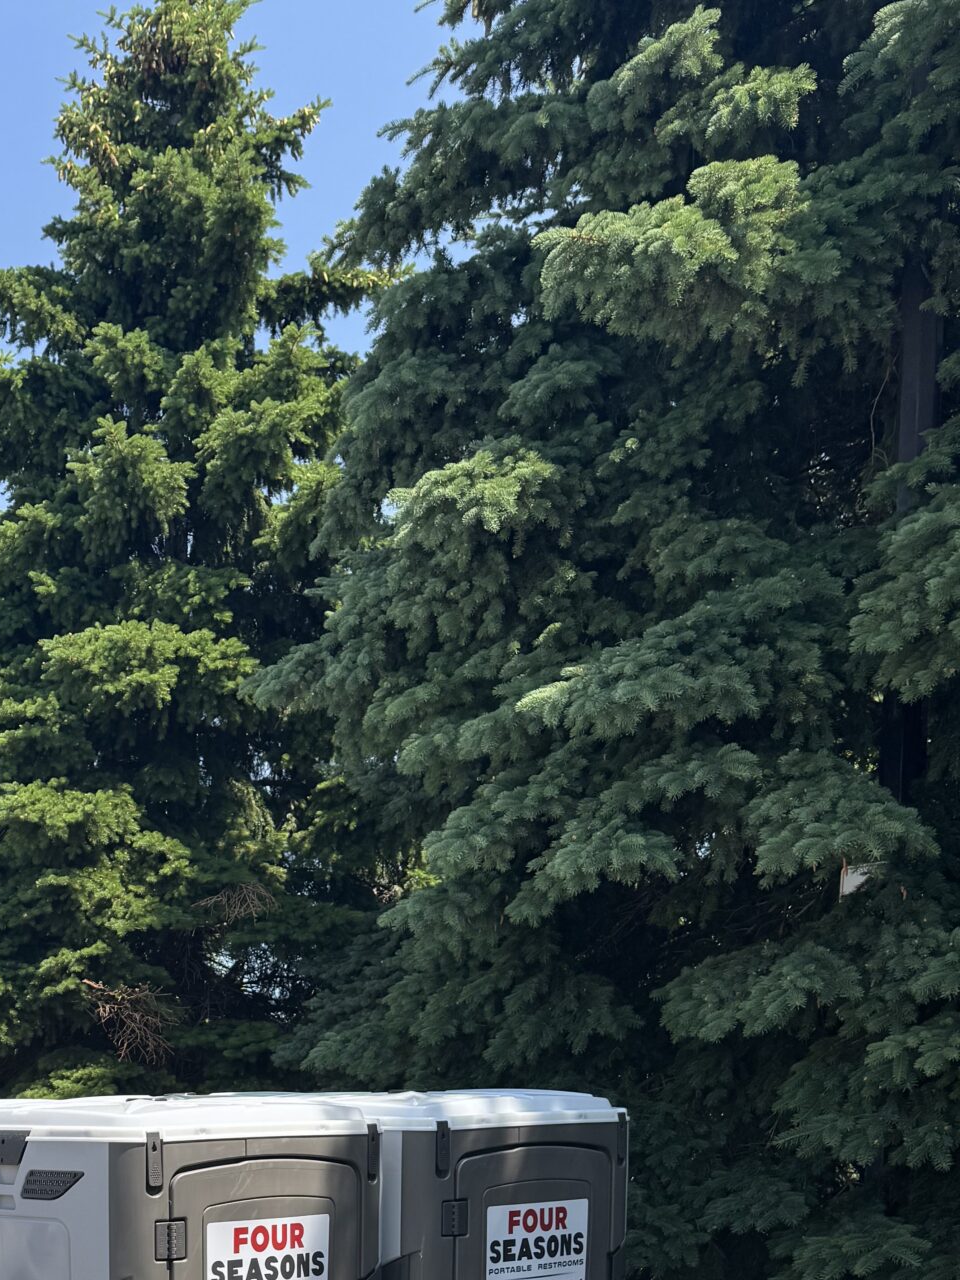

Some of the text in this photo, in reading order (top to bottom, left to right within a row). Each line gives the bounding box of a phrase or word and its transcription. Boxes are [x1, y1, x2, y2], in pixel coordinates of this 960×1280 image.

[508, 1206, 568, 1235] FOUR
[233, 1222, 304, 1254] FOUR
[489, 1232, 584, 1264] SEASONS
[489, 1259, 584, 1275] PORTABLE RESTROOMS
